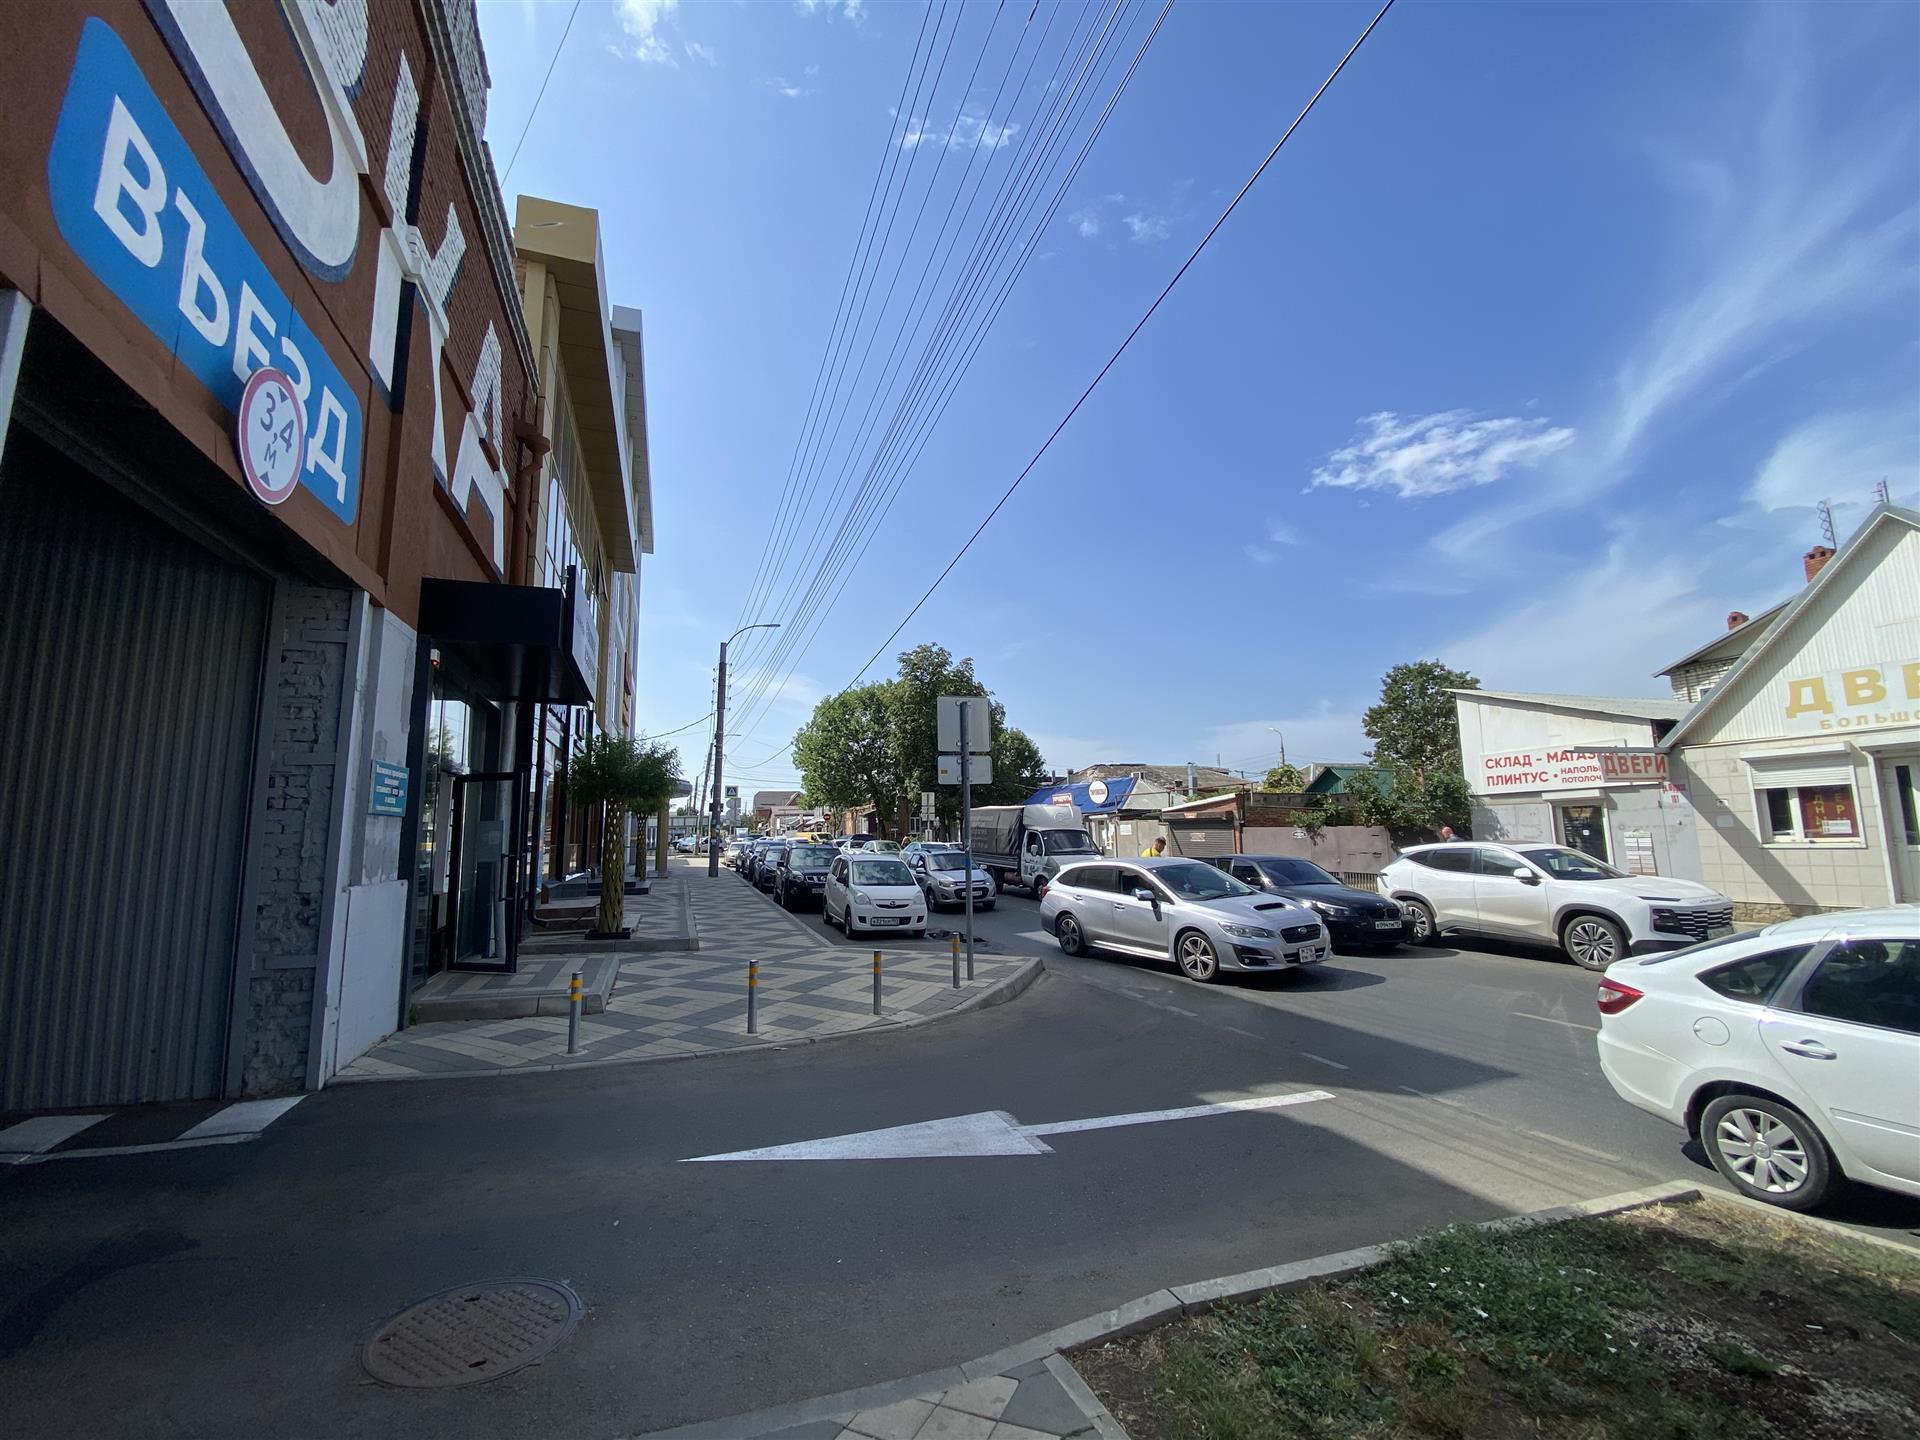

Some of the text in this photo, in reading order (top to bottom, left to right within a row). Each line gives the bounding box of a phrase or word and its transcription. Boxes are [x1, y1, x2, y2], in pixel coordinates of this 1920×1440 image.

[1485, 755, 1532, 769] СКЛАД
[1546, 751, 1600, 763] МАГАЗ
[1603, 754, 1667, 776] ДВЕРИ
[1560, 765, 1599, 775] НАПОЛЬ
[1487, 771, 1549, 787] ПЛИНТУС
[1561, 775, 1601, 784] ПОТОЛОЧ
